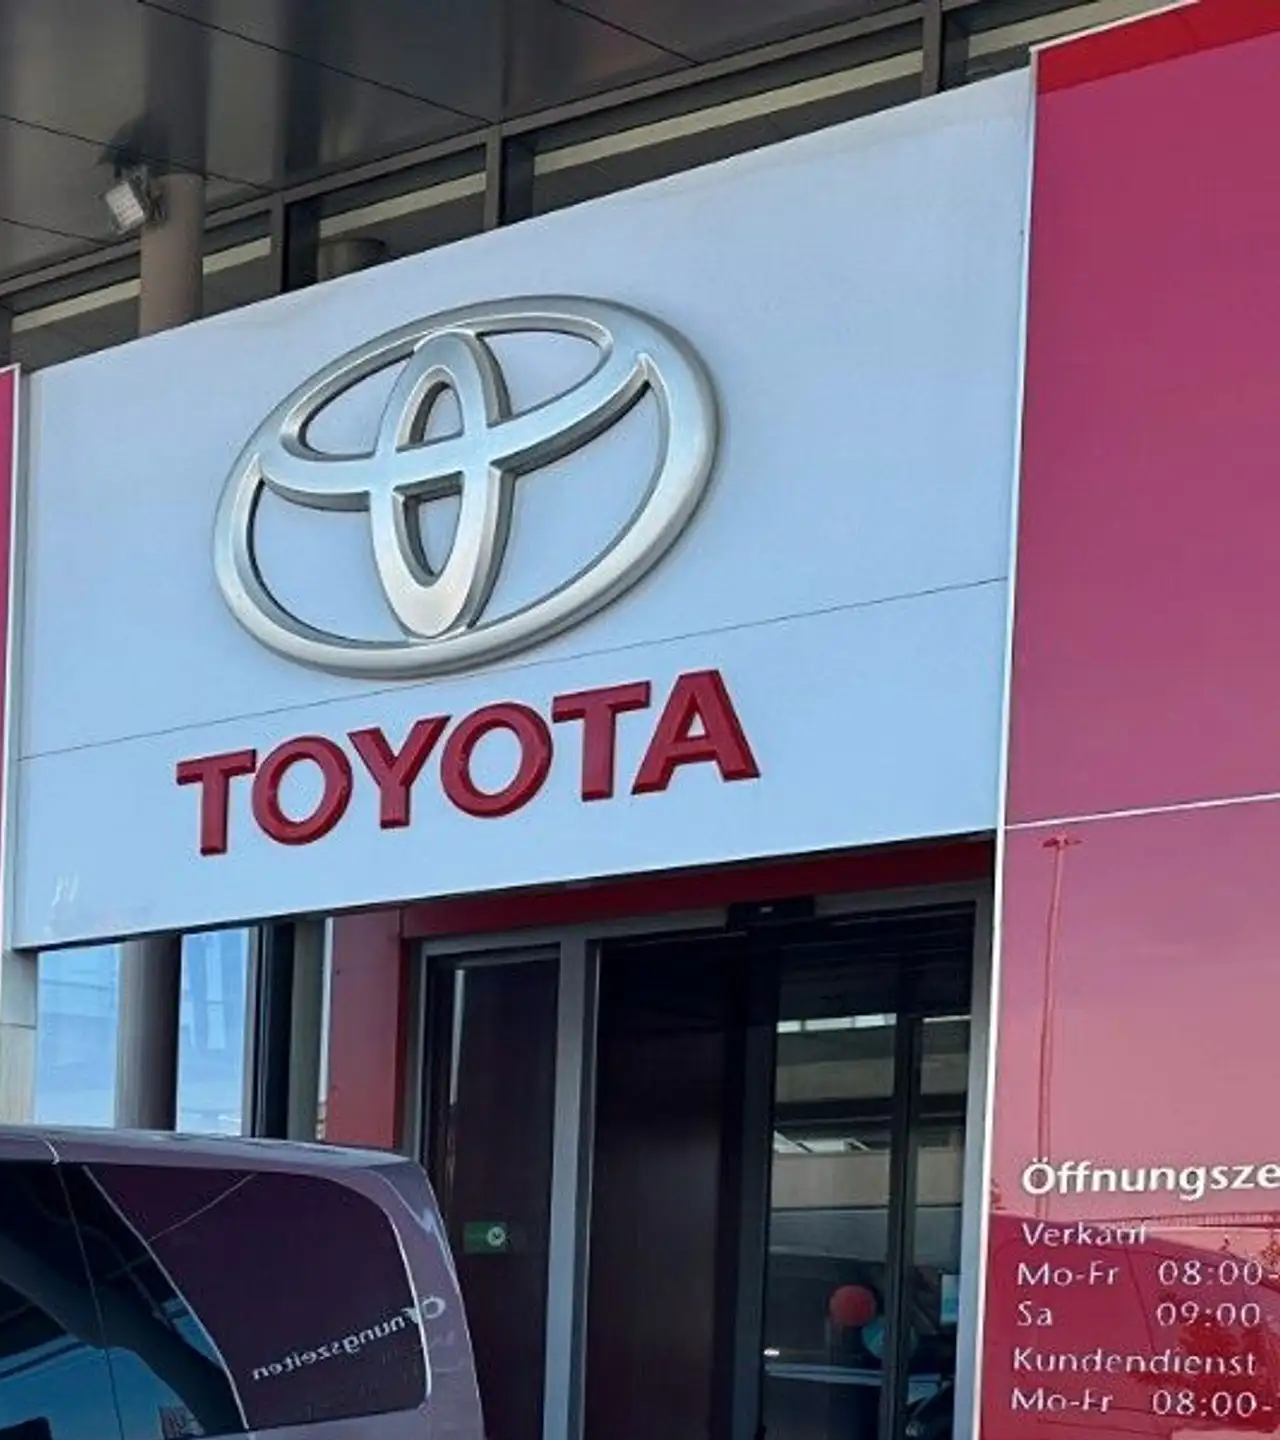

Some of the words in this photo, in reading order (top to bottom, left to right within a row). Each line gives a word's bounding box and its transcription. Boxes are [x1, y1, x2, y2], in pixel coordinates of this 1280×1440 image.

[175, 669, 761, 856] TOYOTA
[1022, 1156, 1280, 1200] Öffnungsze
[1022, 1221, 1147, 1247] Verkauf
[1017, 1260, 1120, 1286] Mo-Fr
[1017, 1300, 1052, 1326] Sa
[1013, 1347, 1256, 1376] Kundendienst
[1011, 1387, 1113, 1413] Mo-Fr
